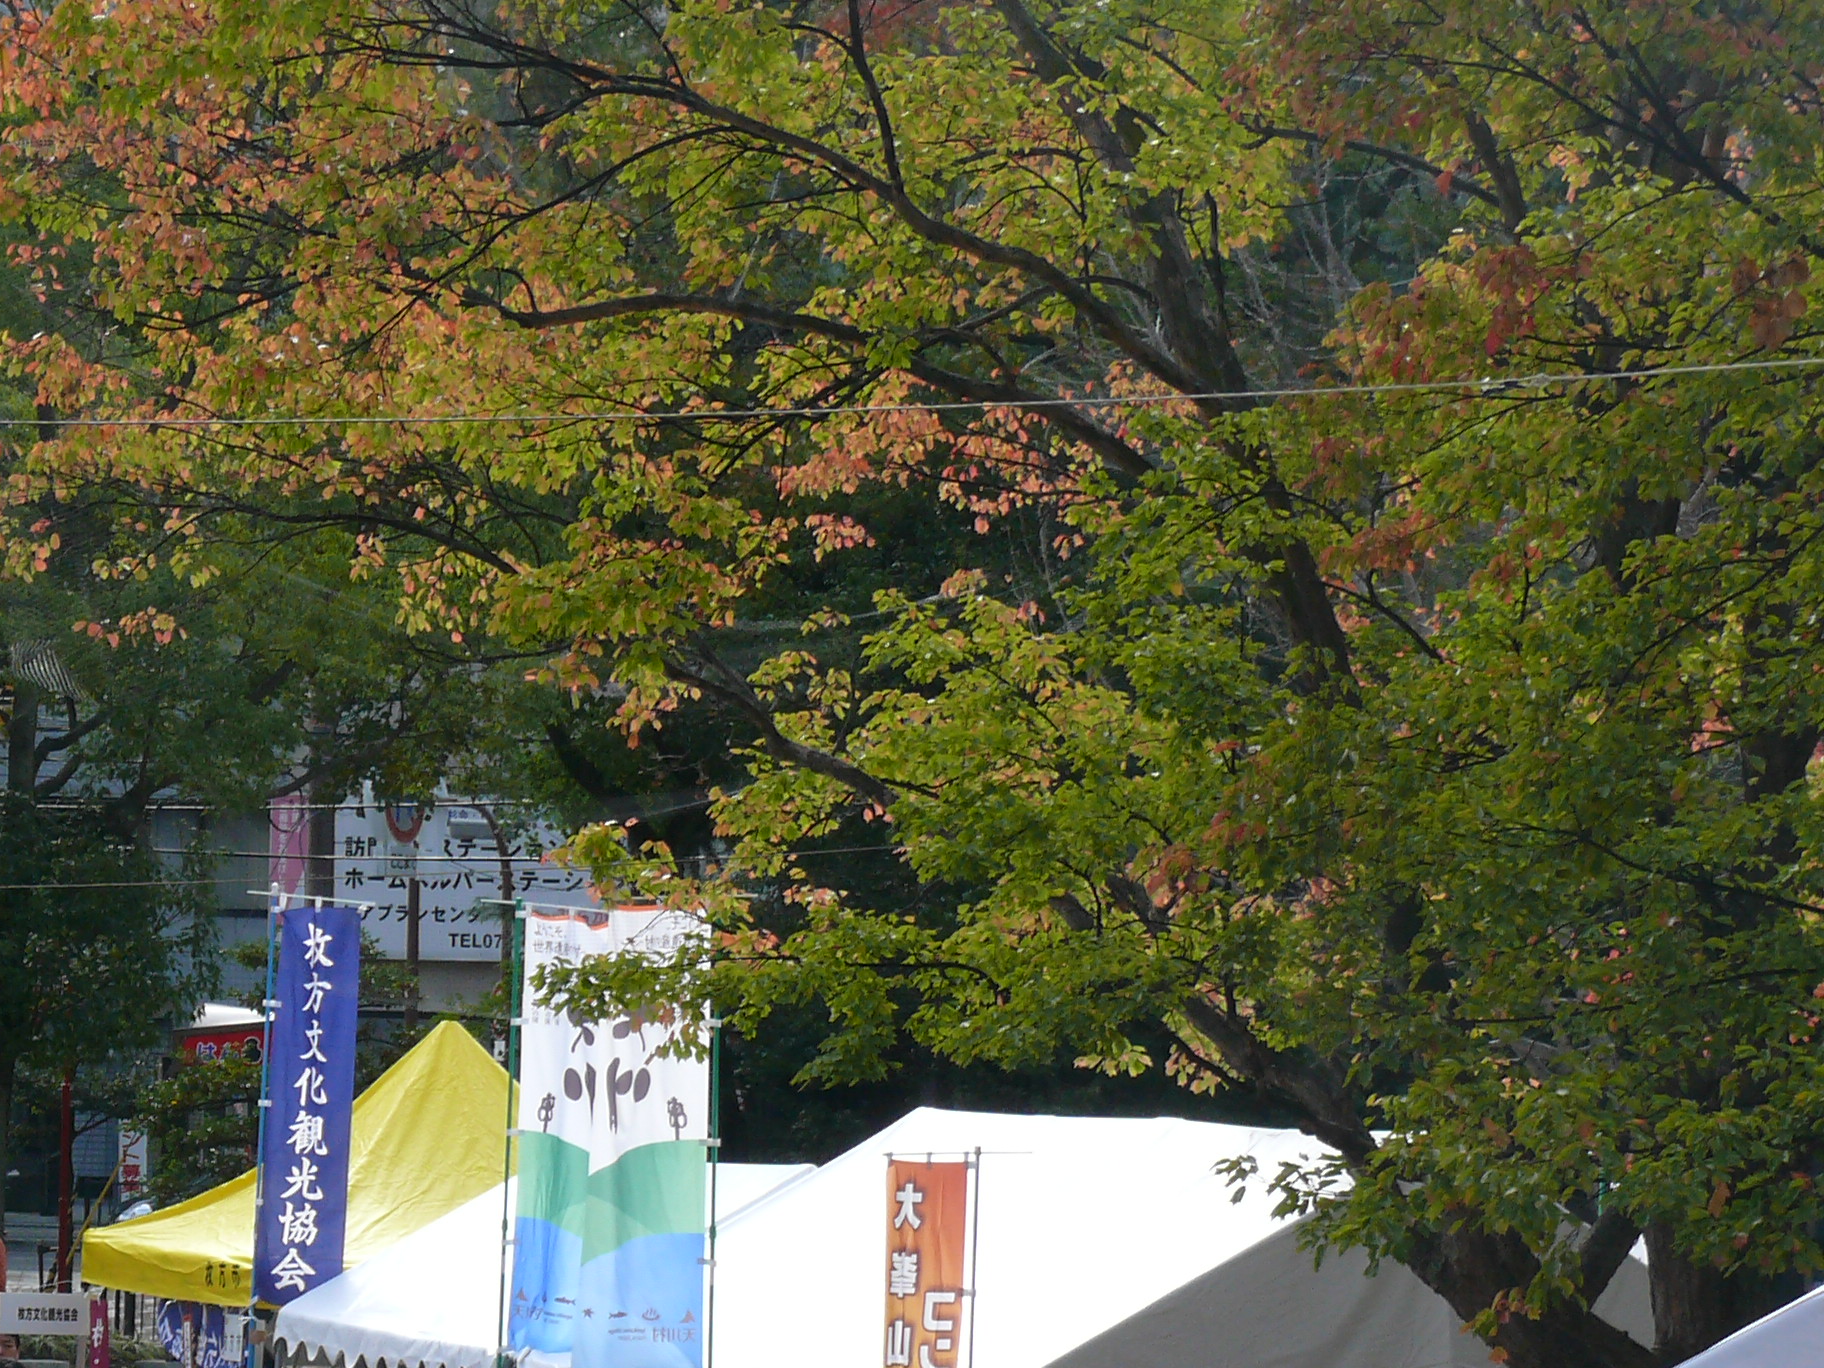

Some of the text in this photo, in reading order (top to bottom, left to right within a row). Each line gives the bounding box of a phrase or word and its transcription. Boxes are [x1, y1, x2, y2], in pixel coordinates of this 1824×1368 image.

[271, 922, 335, 1292] 枚方文化観光協会
[17, 1307, 78, 1322] 枚方文化観光協会
